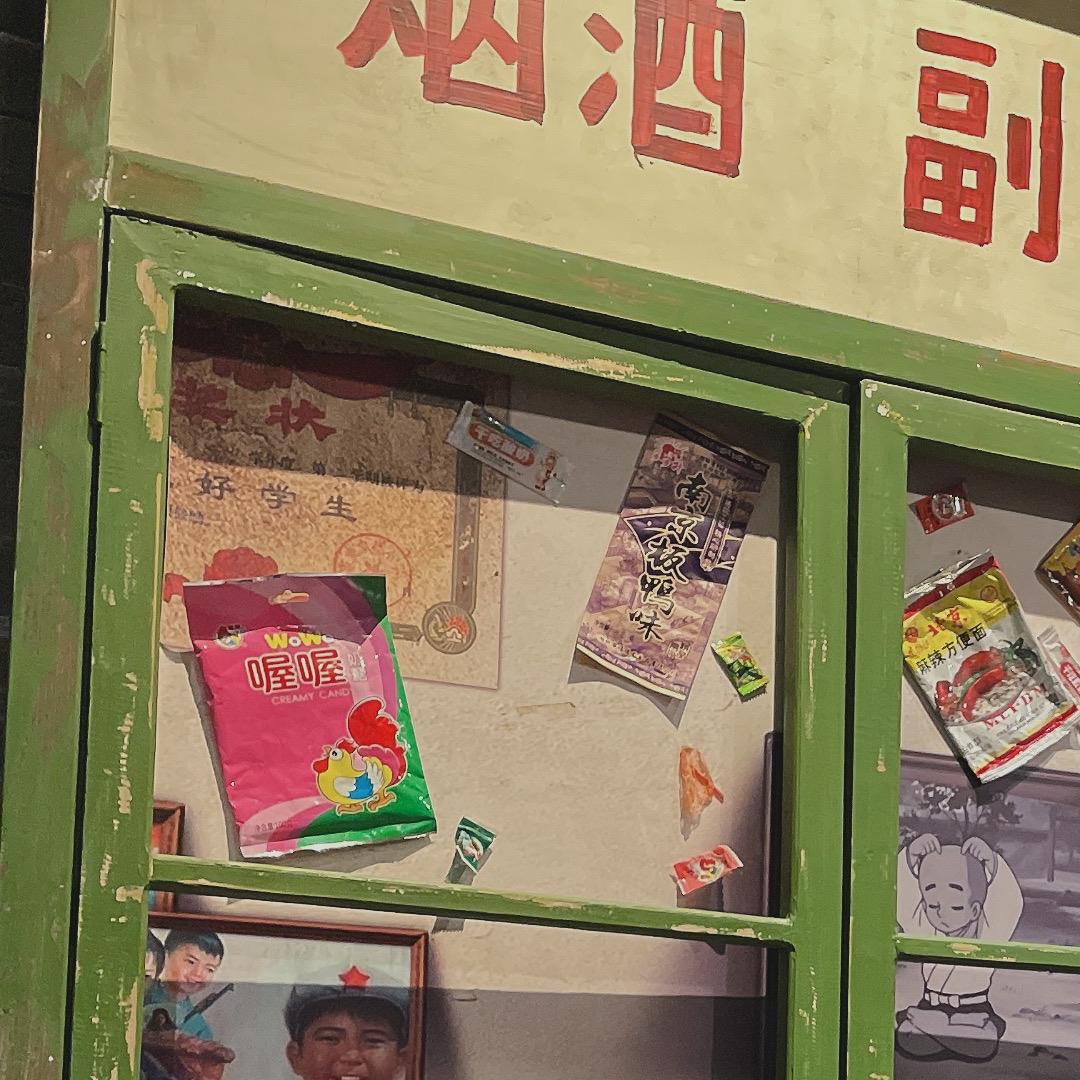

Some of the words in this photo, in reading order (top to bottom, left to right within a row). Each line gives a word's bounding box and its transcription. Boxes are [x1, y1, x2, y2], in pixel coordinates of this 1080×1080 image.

[337, 0, 744, 178] 烟酒
[198, 471, 357, 523] 好学生
[246, 649, 348, 693] 喔喔
[916, 622, 988, 676] 麻辣方便面
[271, 692, 315, 705] CREAMY
[319, 688, 352, 699] CAND
